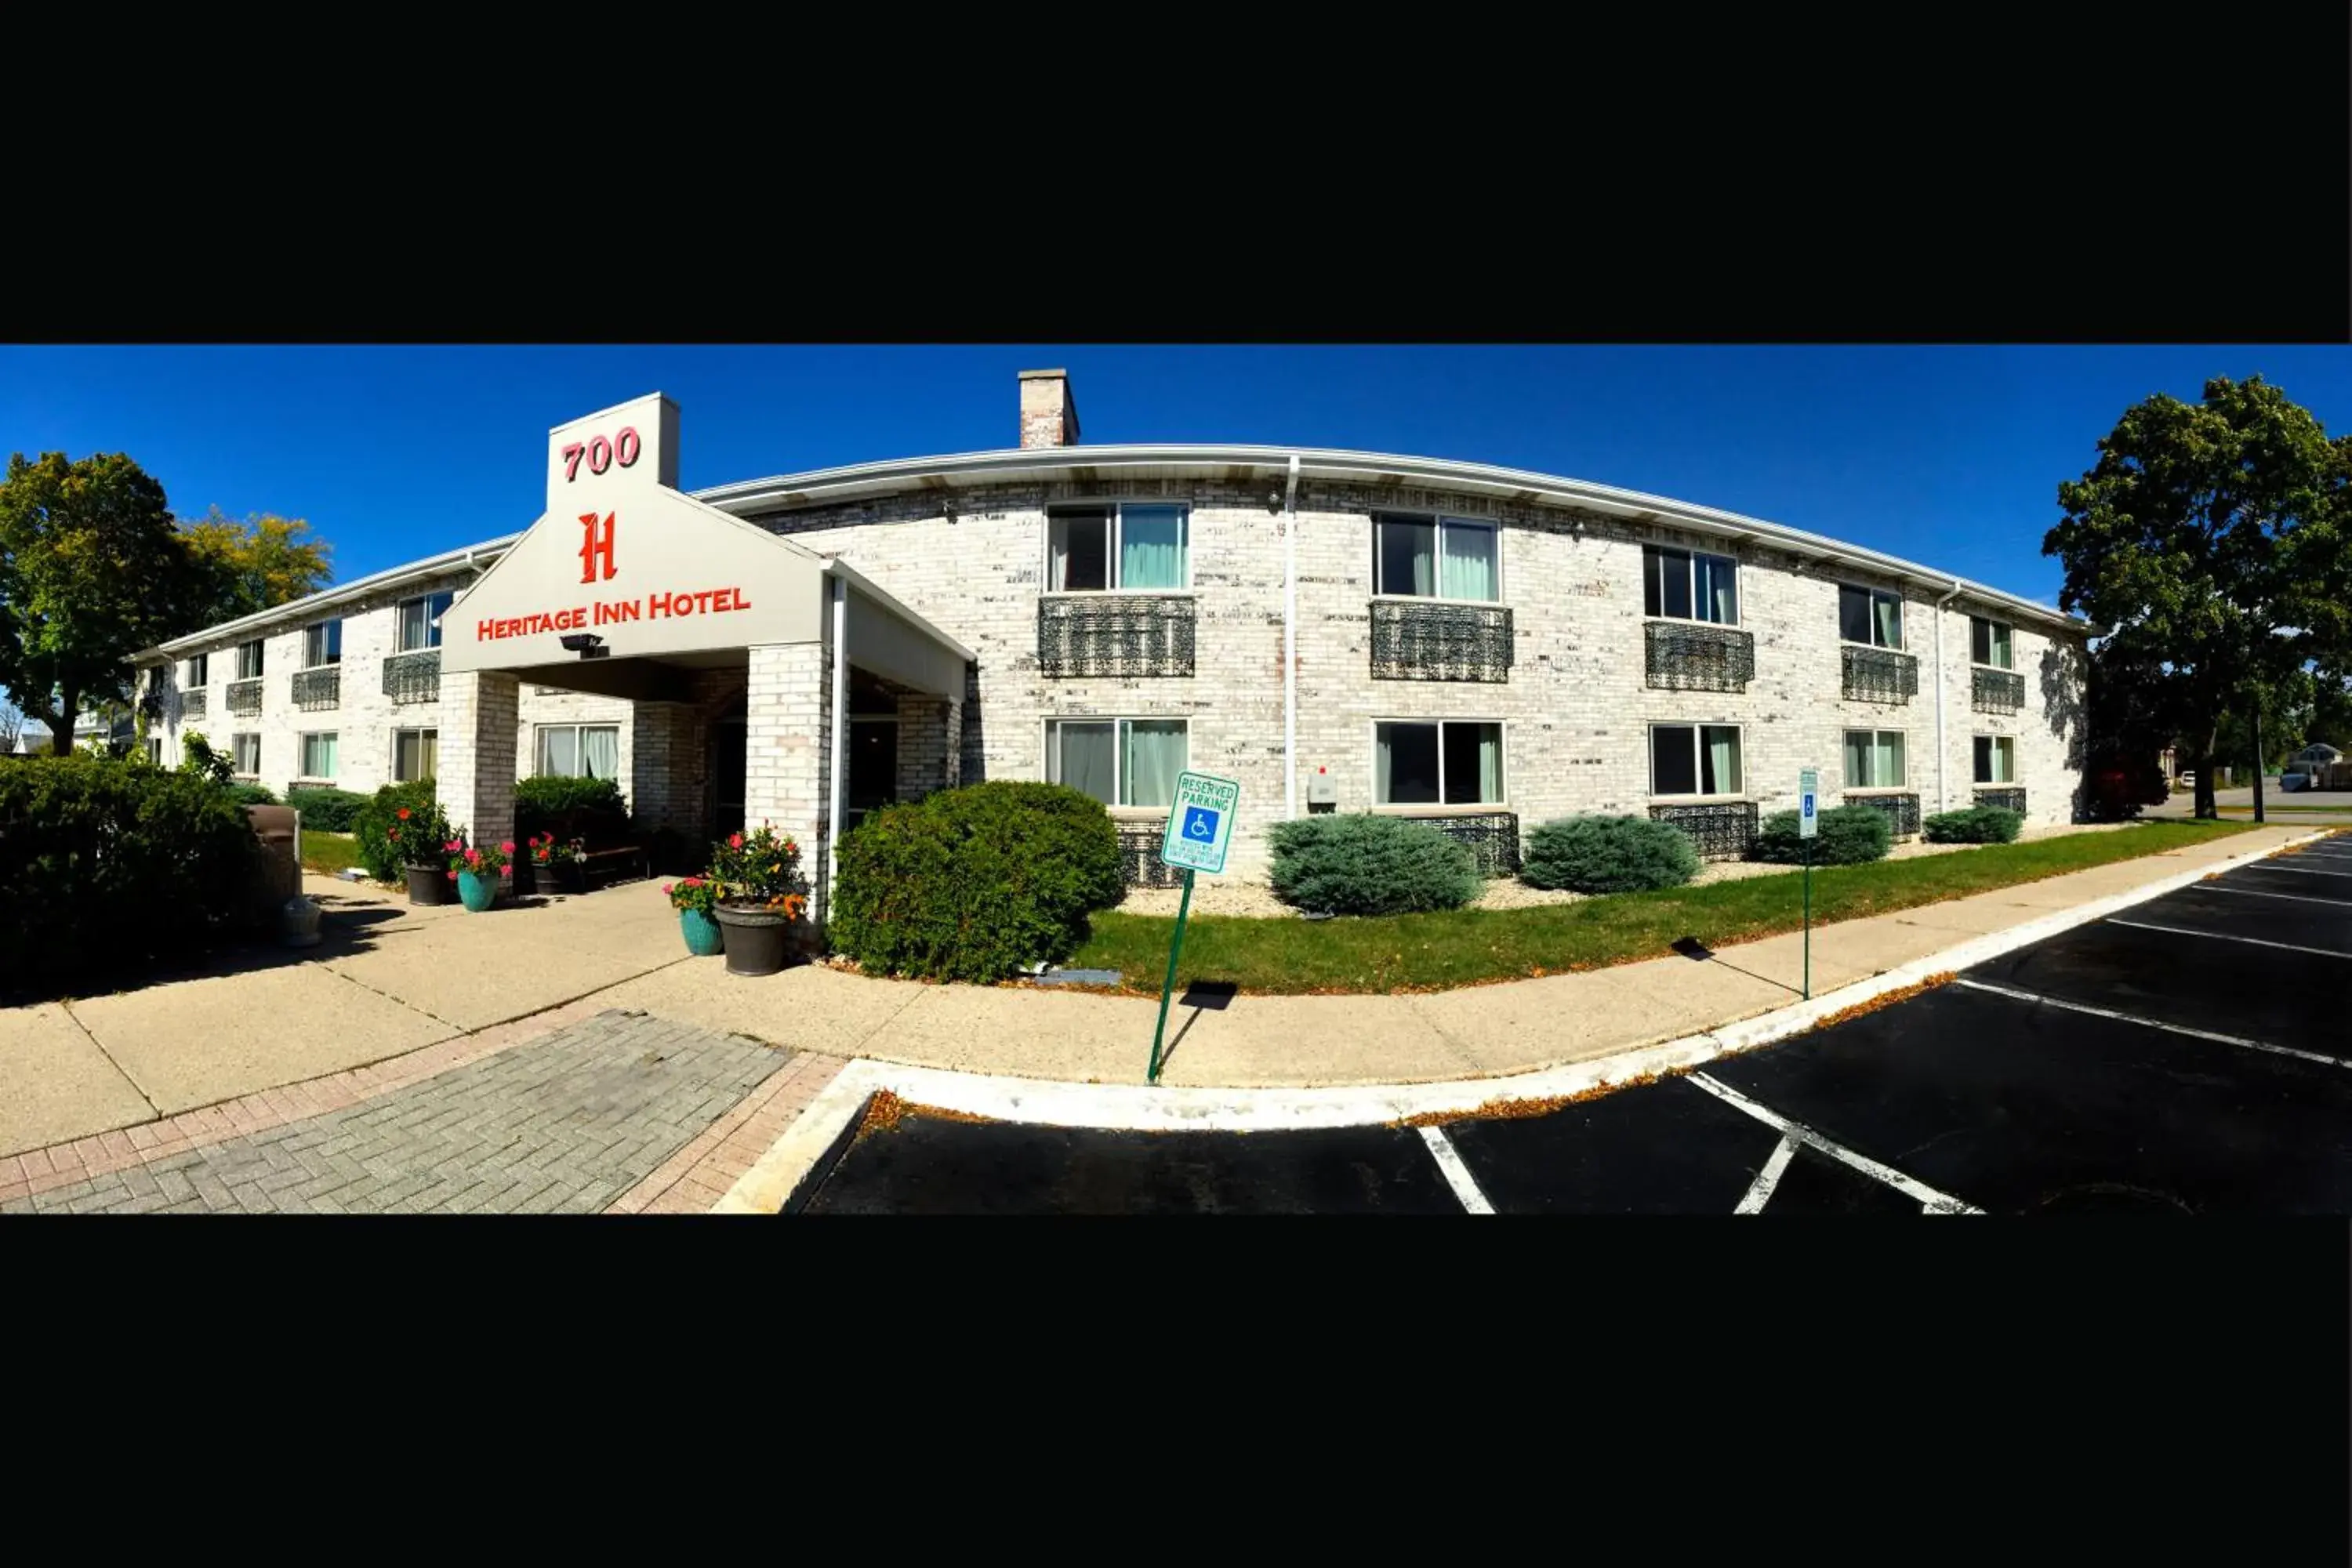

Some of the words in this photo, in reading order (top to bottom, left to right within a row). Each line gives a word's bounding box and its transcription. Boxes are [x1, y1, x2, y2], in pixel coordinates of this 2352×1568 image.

[561, 426, 641, 482] 700
[579, 512, 618, 584] H
[1181, 777, 1234, 800] RESERVED
[1182, 791, 1229, 811] PARKING
